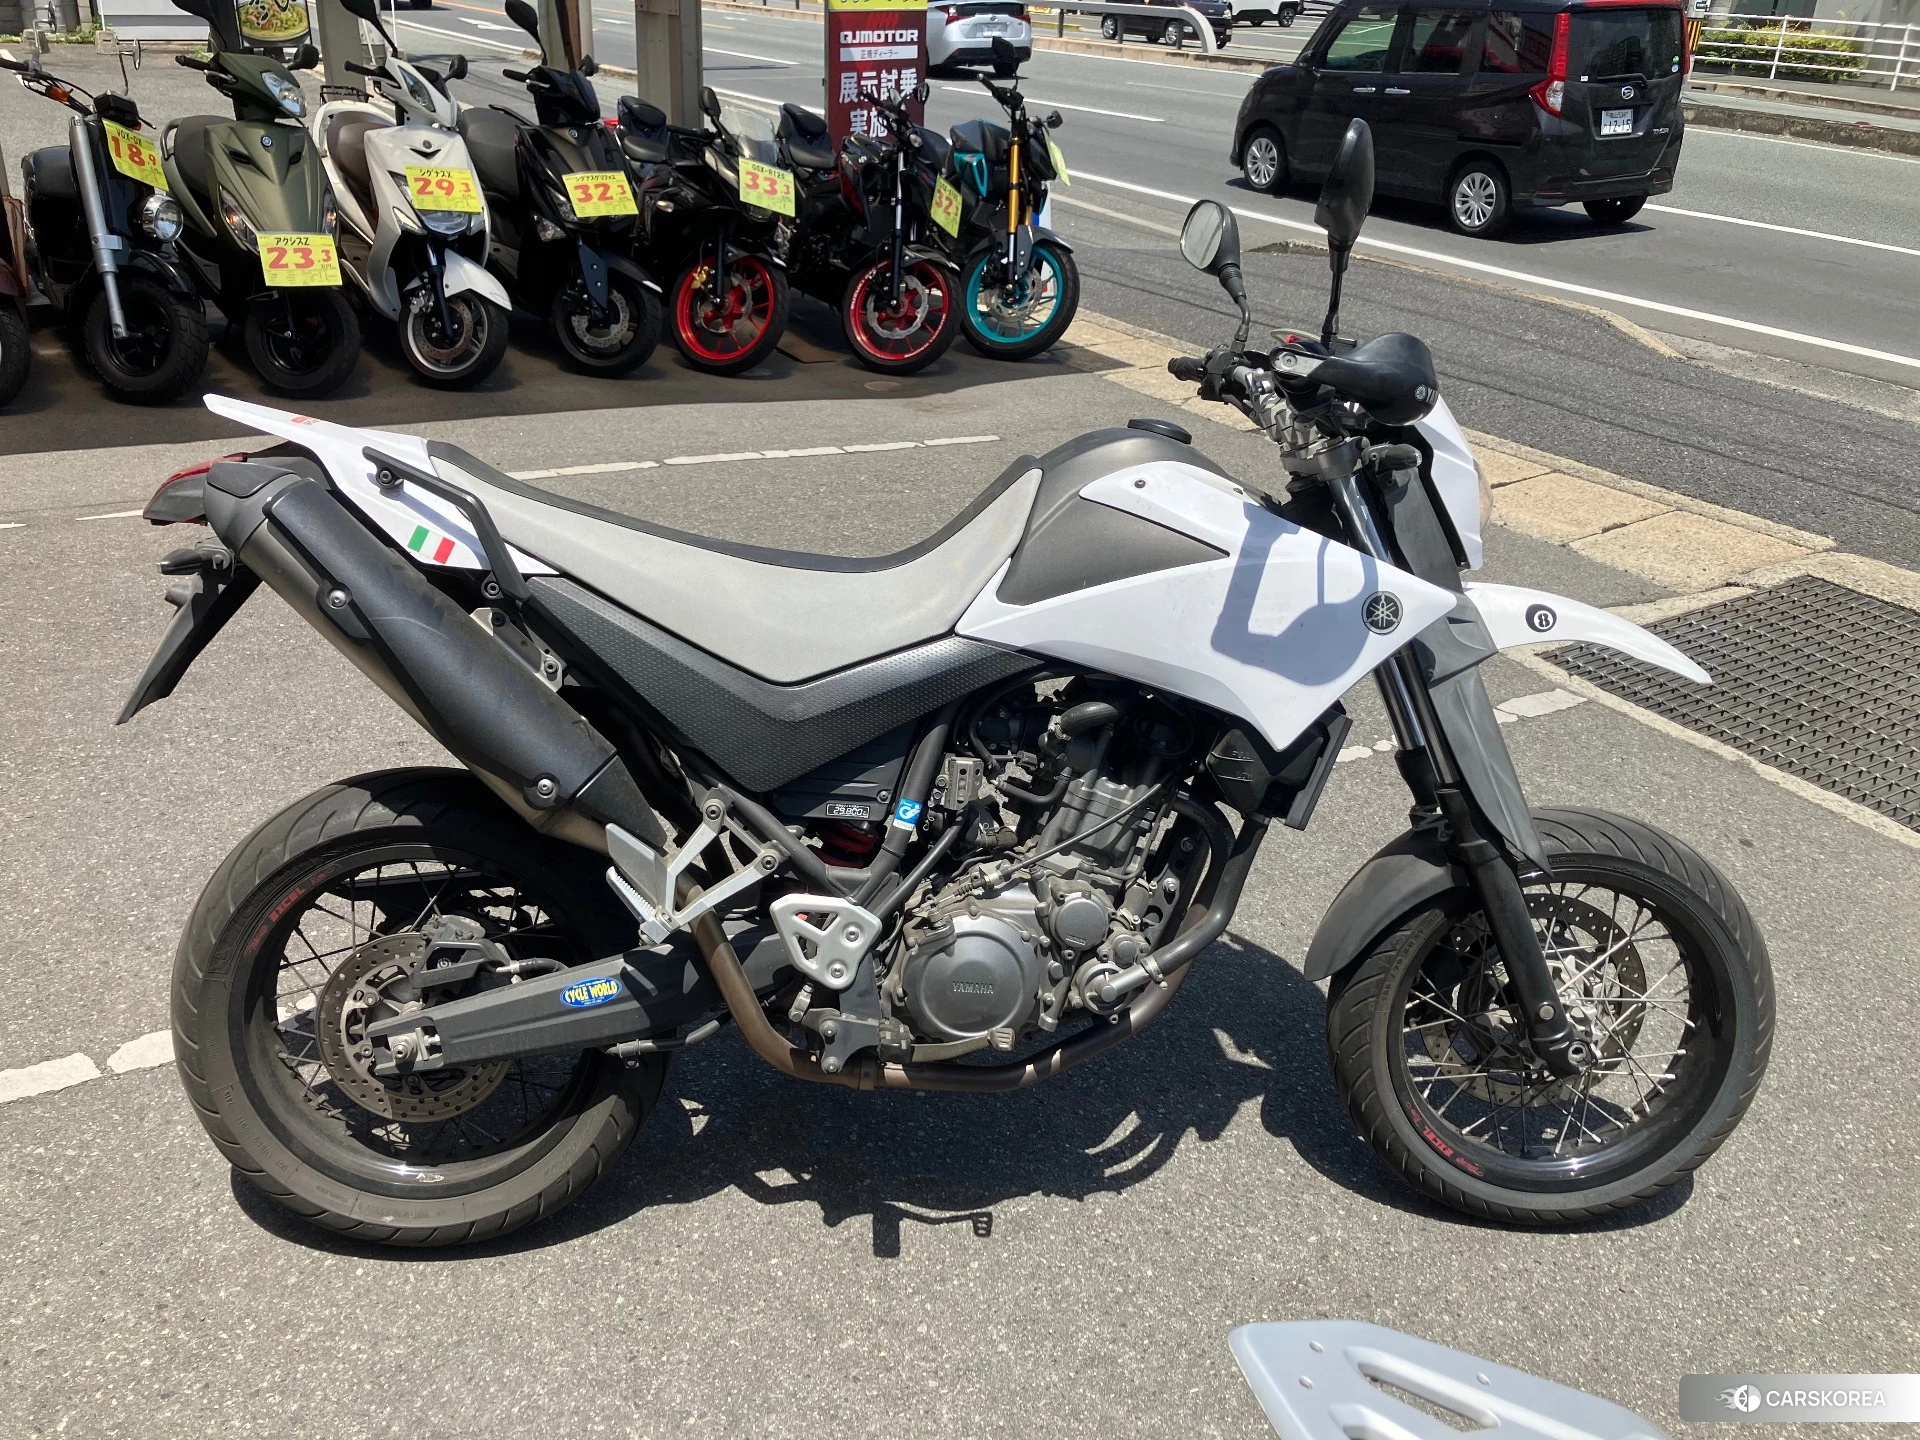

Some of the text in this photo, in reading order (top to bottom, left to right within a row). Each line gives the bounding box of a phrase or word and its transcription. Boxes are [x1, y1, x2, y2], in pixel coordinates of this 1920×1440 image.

[840, 30, 918, 44] QJMOTOR
[839, 68, 917, 103] 展示試乗
[275, 237, 310, 246] アクシスZ
[564, 986, 589, 1003] CYCLE
[589, 980, 618, 999] WORLD
[953, 981, 994, 994] YAMAHA
